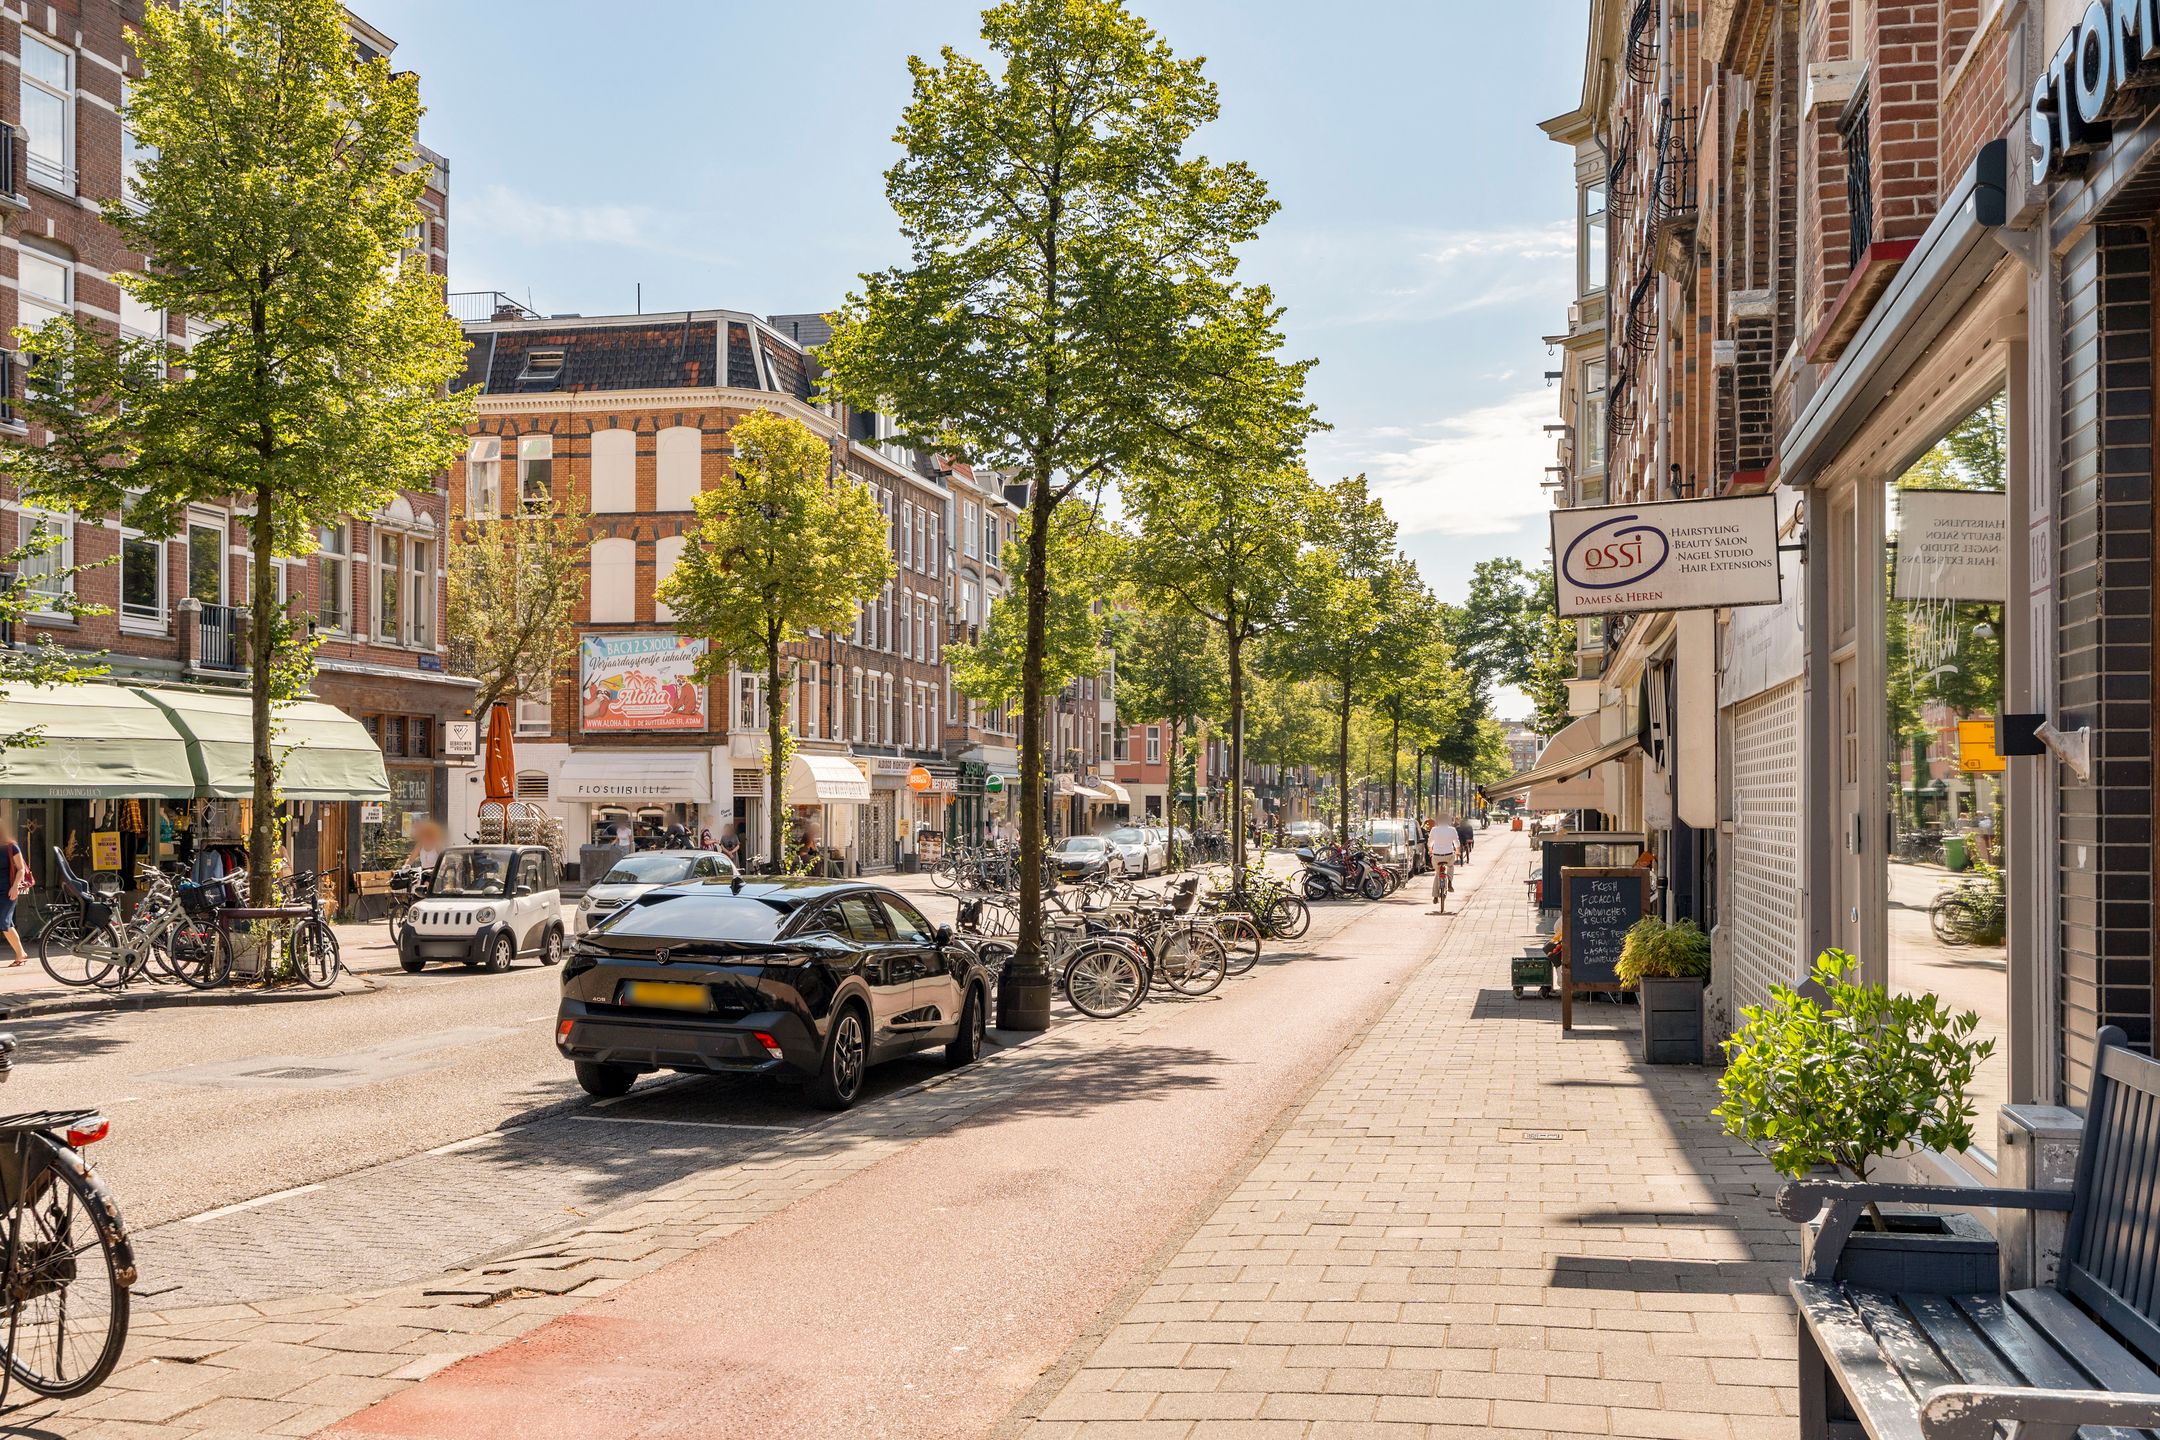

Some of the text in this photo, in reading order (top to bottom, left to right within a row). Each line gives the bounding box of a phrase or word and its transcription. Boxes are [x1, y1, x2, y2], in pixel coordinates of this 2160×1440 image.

[2030, 0, 2160, 185] STOM
[1671, 525, 1740, 537] HAIRSTYLING
[1674, 536, 1748, 549] BEAUTY SALON
[1677, 548, 1754, 561] NAGEL STUDIO
[2031, 531, 2047, 584] 118
[1681, 559, 1773, 573] HAIR EXTENSIONS
[1575, 591, 1663, 606] DAMES & HEREN
[607, 642, 632, 655] BACK
[634, 641, 640, 652] 2
[588, 646, 699, 671] Verjaardagsfeestje inhalen?
[618, 688, 666, 705] Aloha
[409, 780, 426, 799] BAR
[1591, 880, 1618, 892] FRESH
[1580, 892, 1621, 907] FOCACCIA
[1577, 907, 1627, 919] SANDWICHES
[1590, 916, 1617, 925] SLICES
[1581, 930, 1605, 940] FRESH
